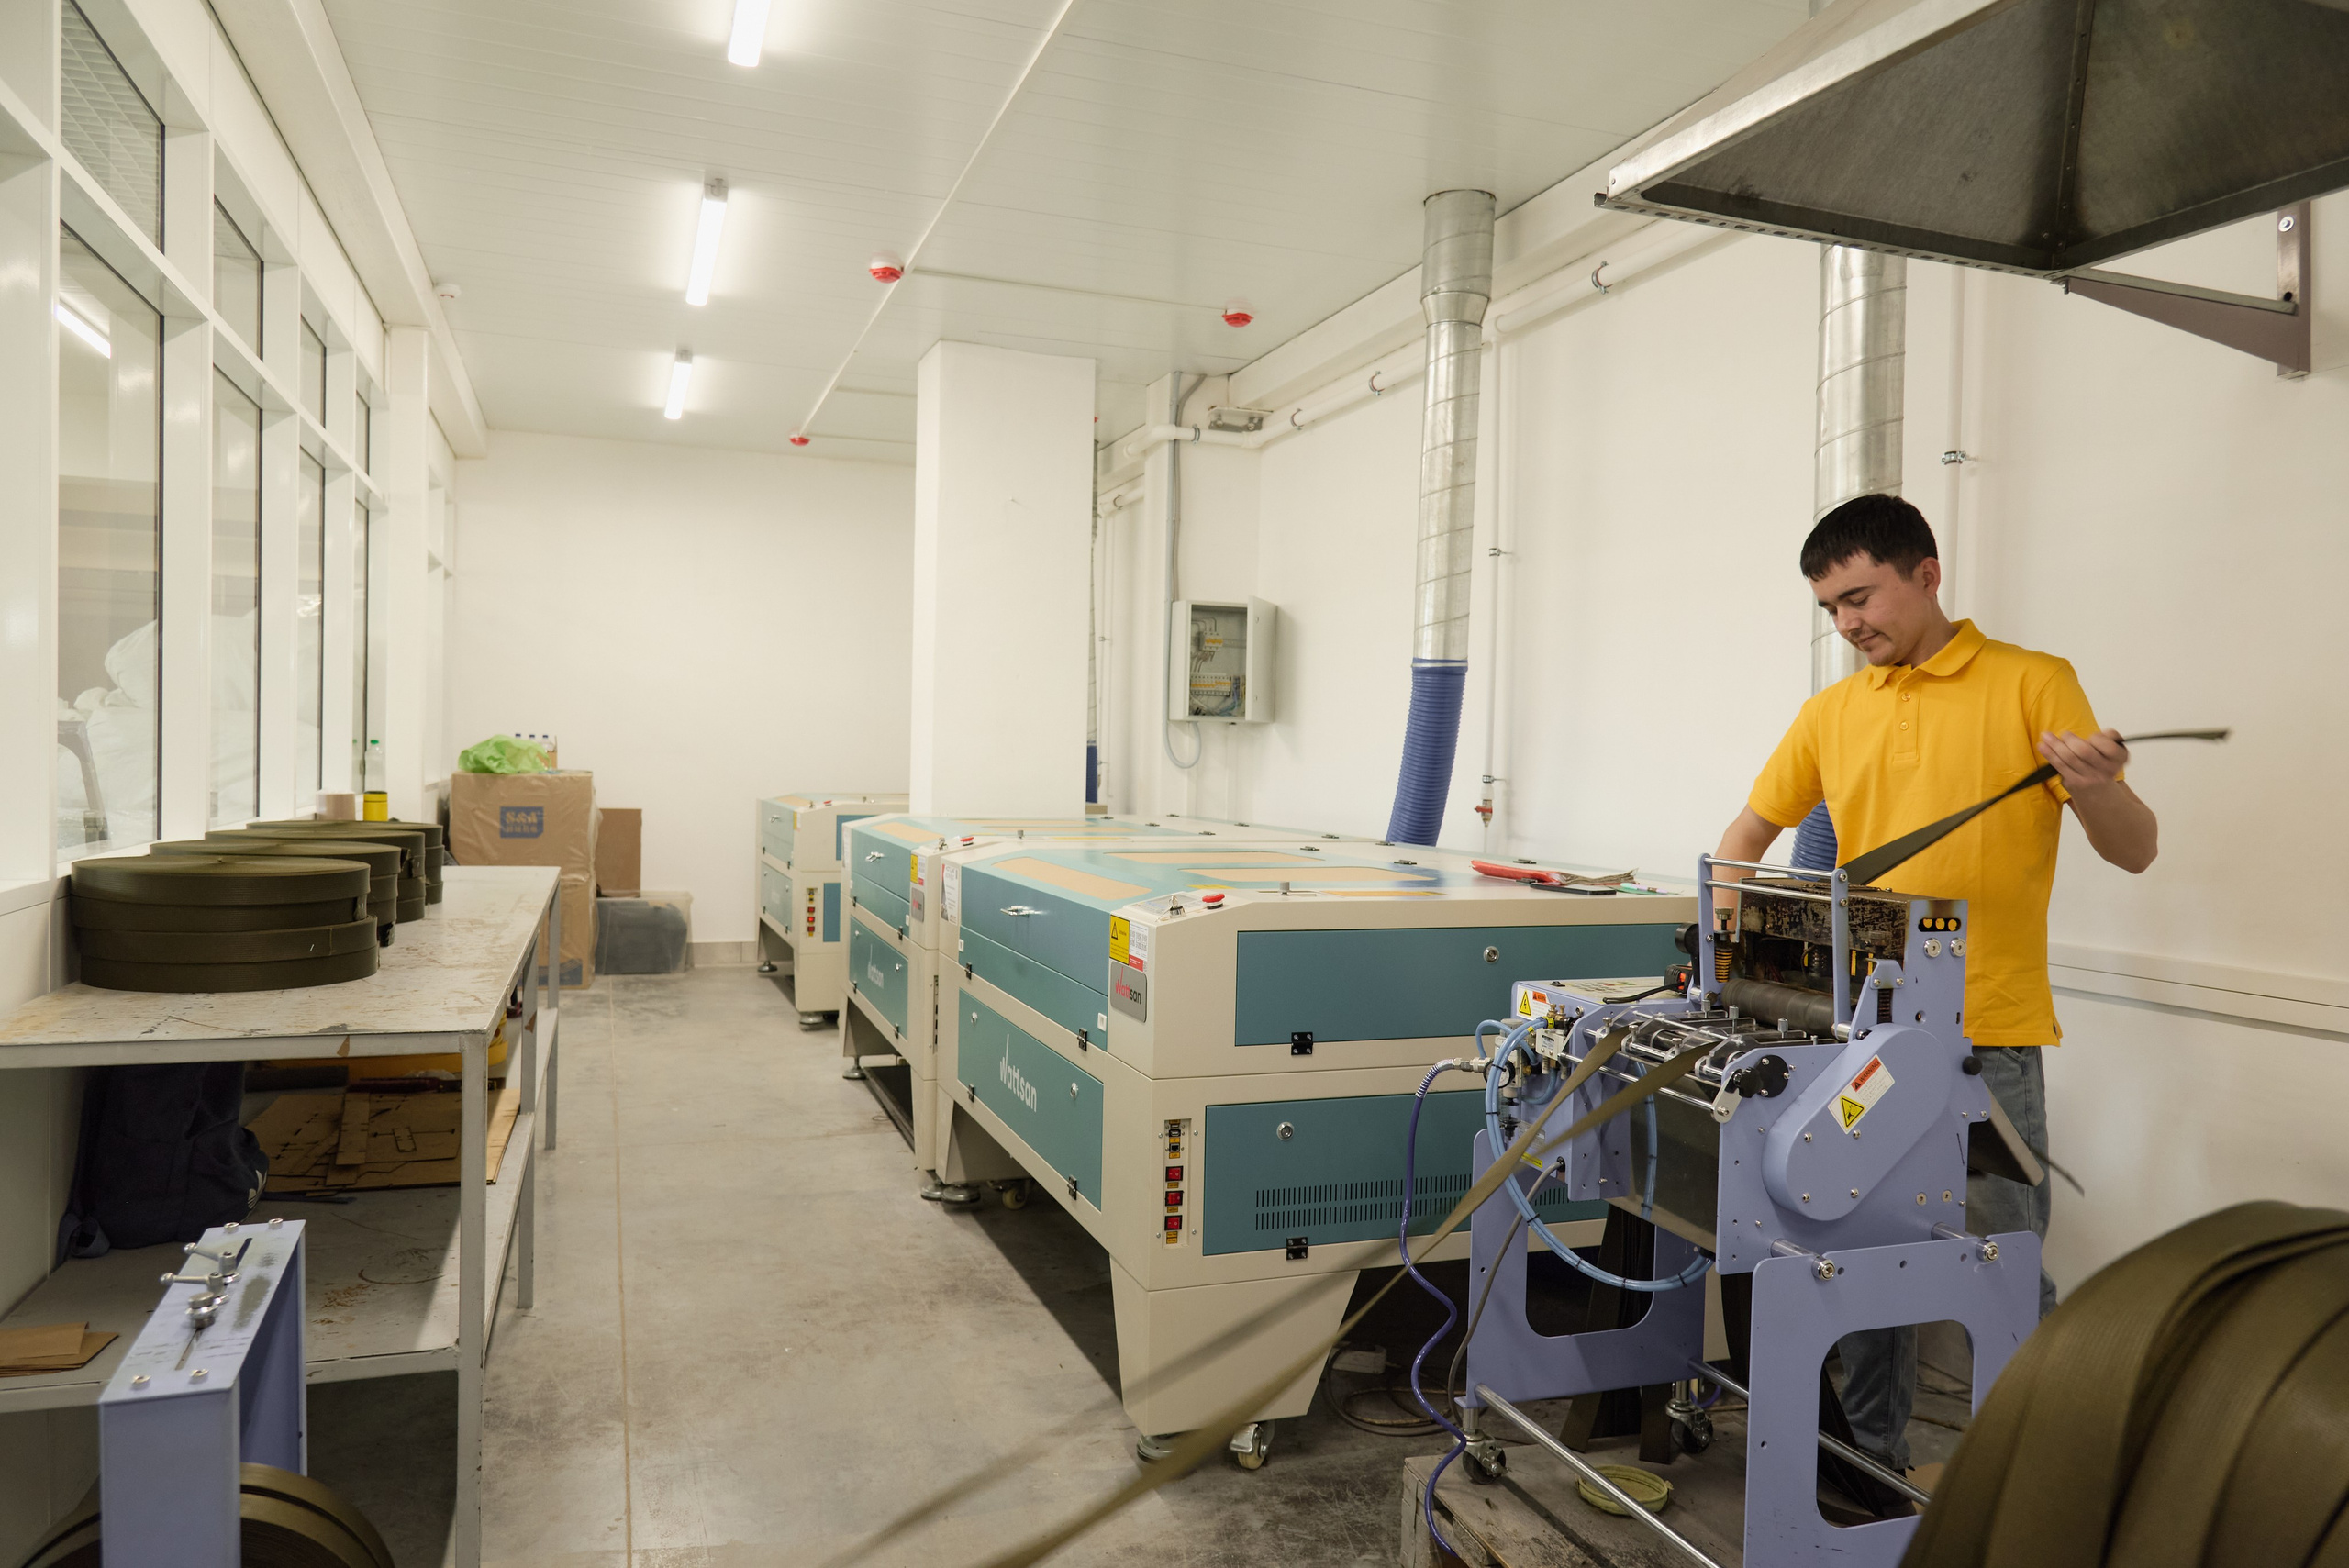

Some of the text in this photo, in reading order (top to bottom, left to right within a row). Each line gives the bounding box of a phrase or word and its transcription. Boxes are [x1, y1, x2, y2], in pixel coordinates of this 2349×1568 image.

[1115, 966, 1141, 1005] Wattsan
[1000, 1033, 1037, 1113] Wattsan
[1858, 1059, 1881, 1083] WARNING
